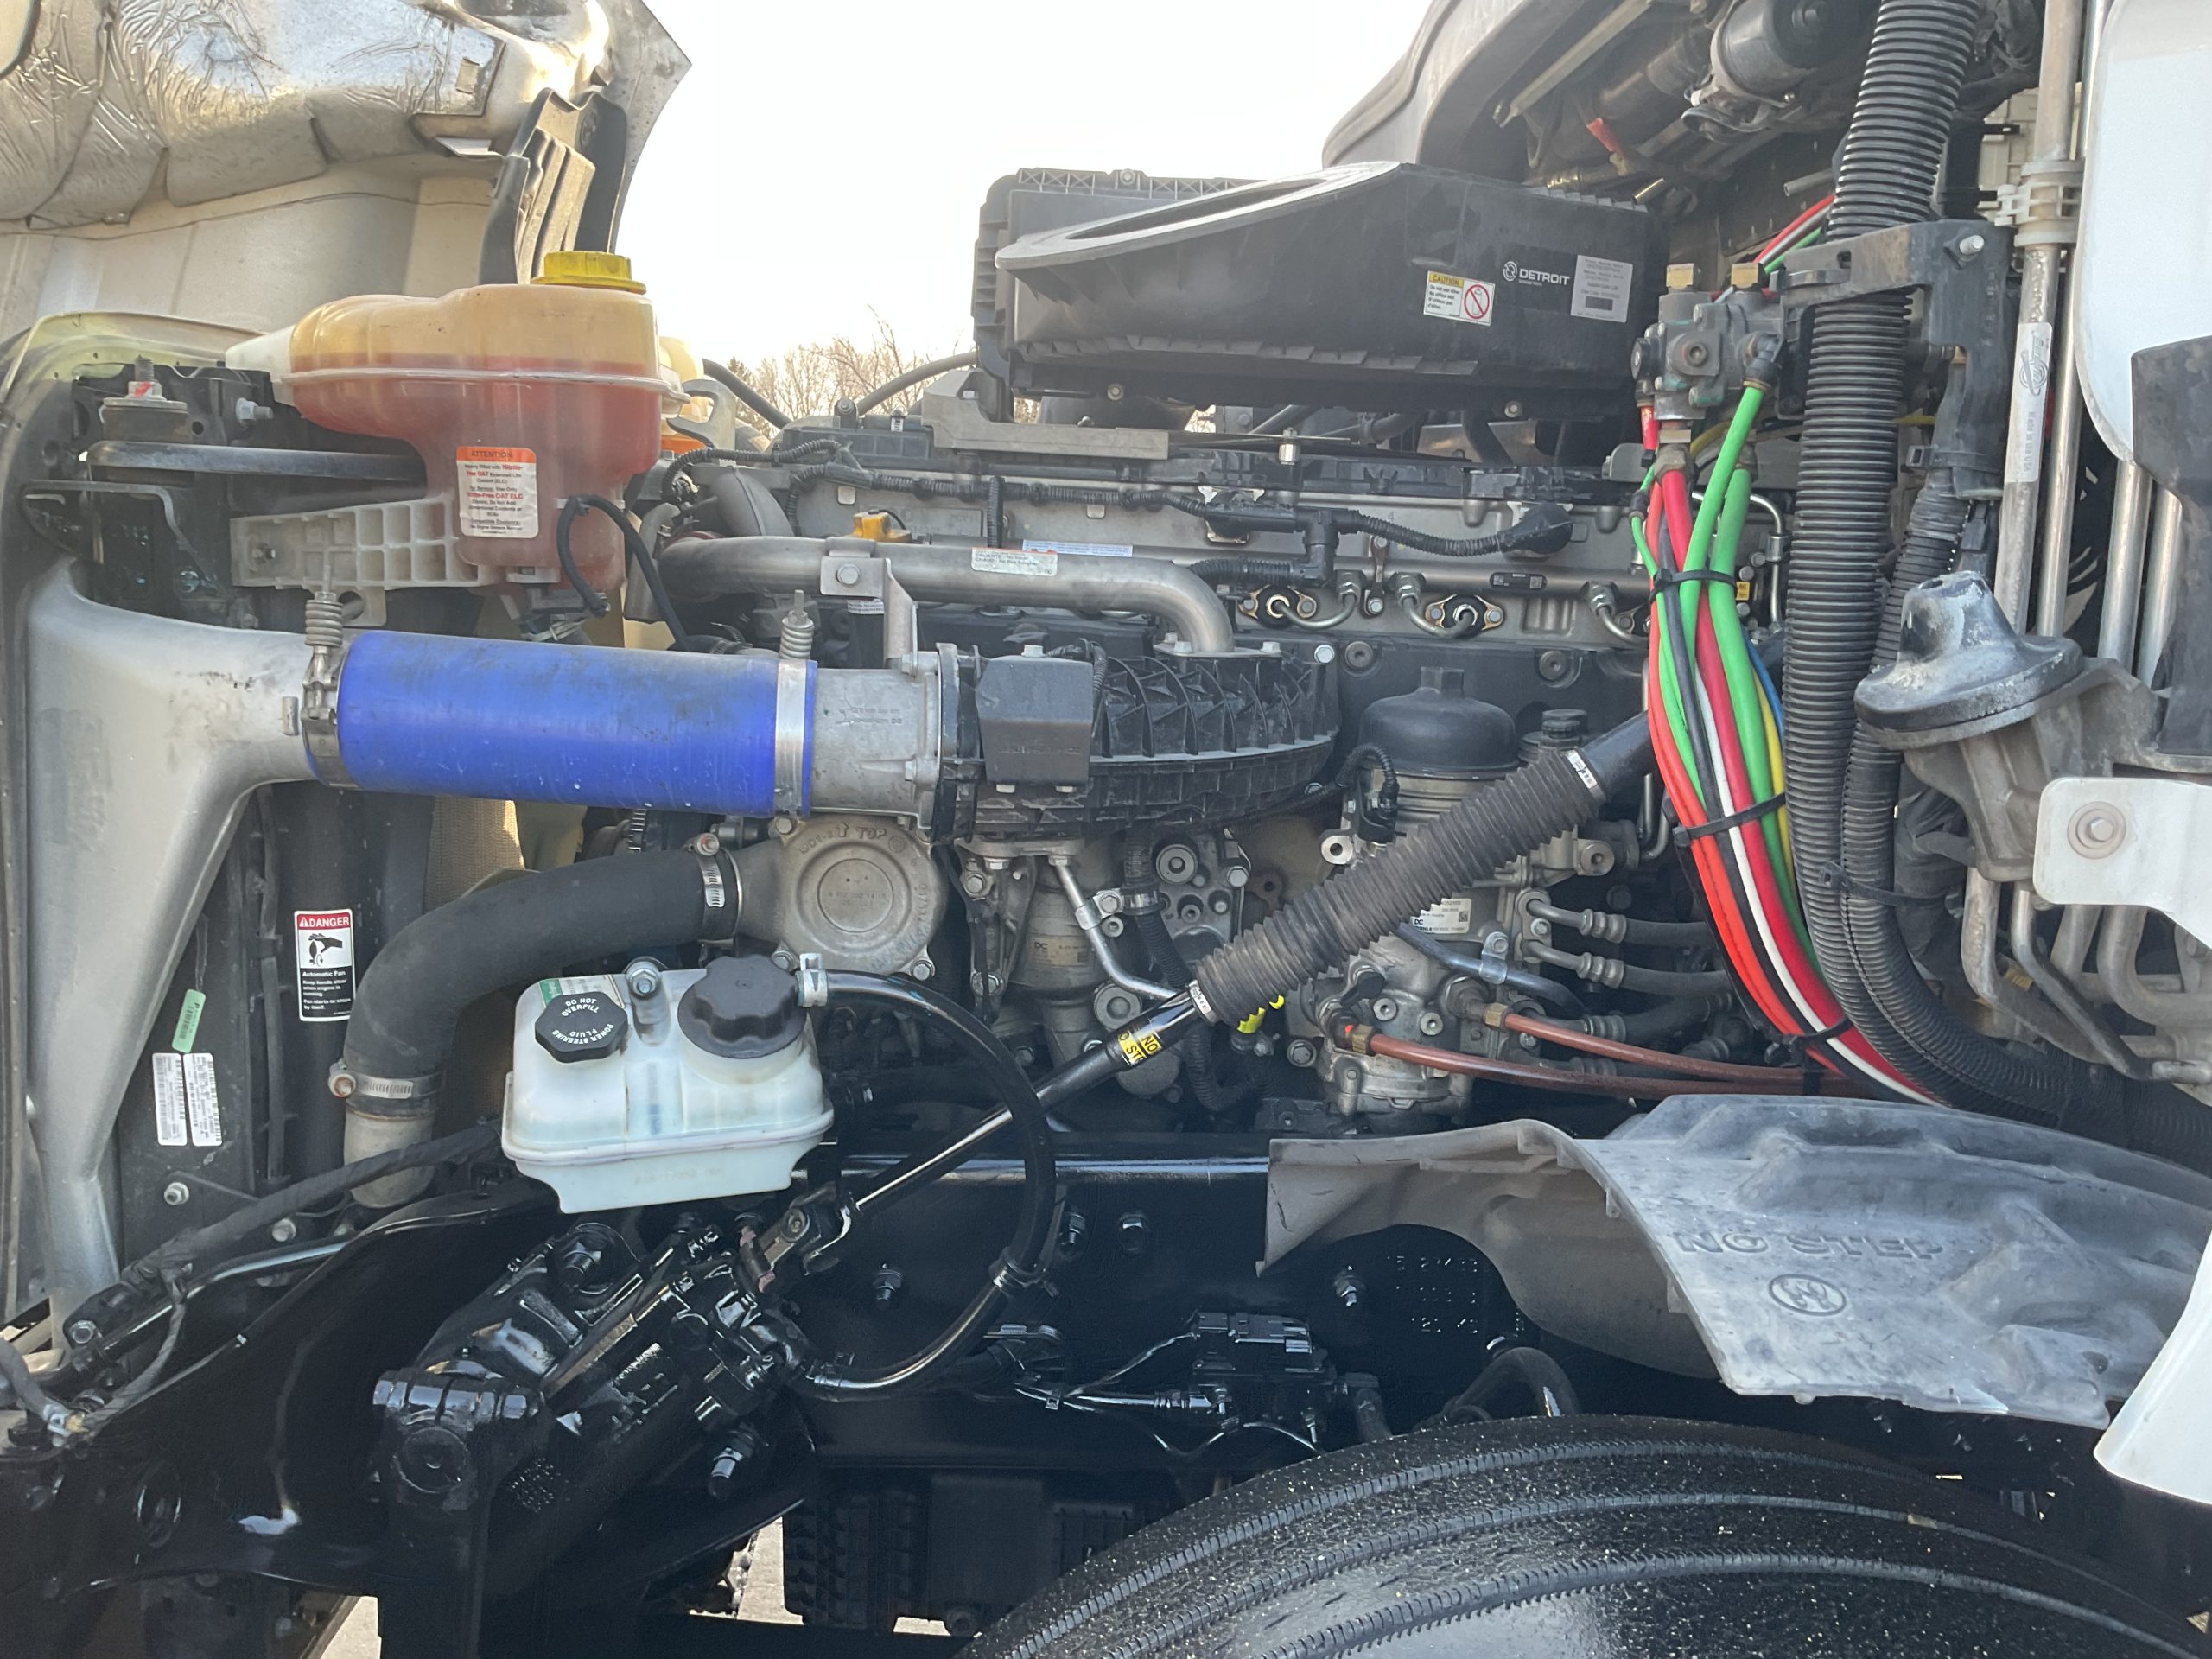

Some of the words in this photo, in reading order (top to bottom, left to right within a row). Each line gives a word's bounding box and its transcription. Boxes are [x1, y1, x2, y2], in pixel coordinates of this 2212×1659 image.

[1432, 274, 1460, 286] CAUTION
[1519, 268, 1570, 286] DETROIT
[471, 450, 513, 459] ATTENTION
[855, 826, 887, 840] TOP
[308, 916, 350, 928] DANGER
[1034, 941, 1048, 950] DC
[565, 999, 577, 1007] DO
[561, 1004, 601, 1017] OVERFILL
[551, 1029, 589, 1045] STEERING
[569, 1028, 598, 1038] FLUID
[590, 1023, 614, 1043] POWER
[1141, 1036, 1159, 1052] NO
[1673, 1230, 1769, 1254] NO
[1786, 1234, 1944, 1261] STEP
